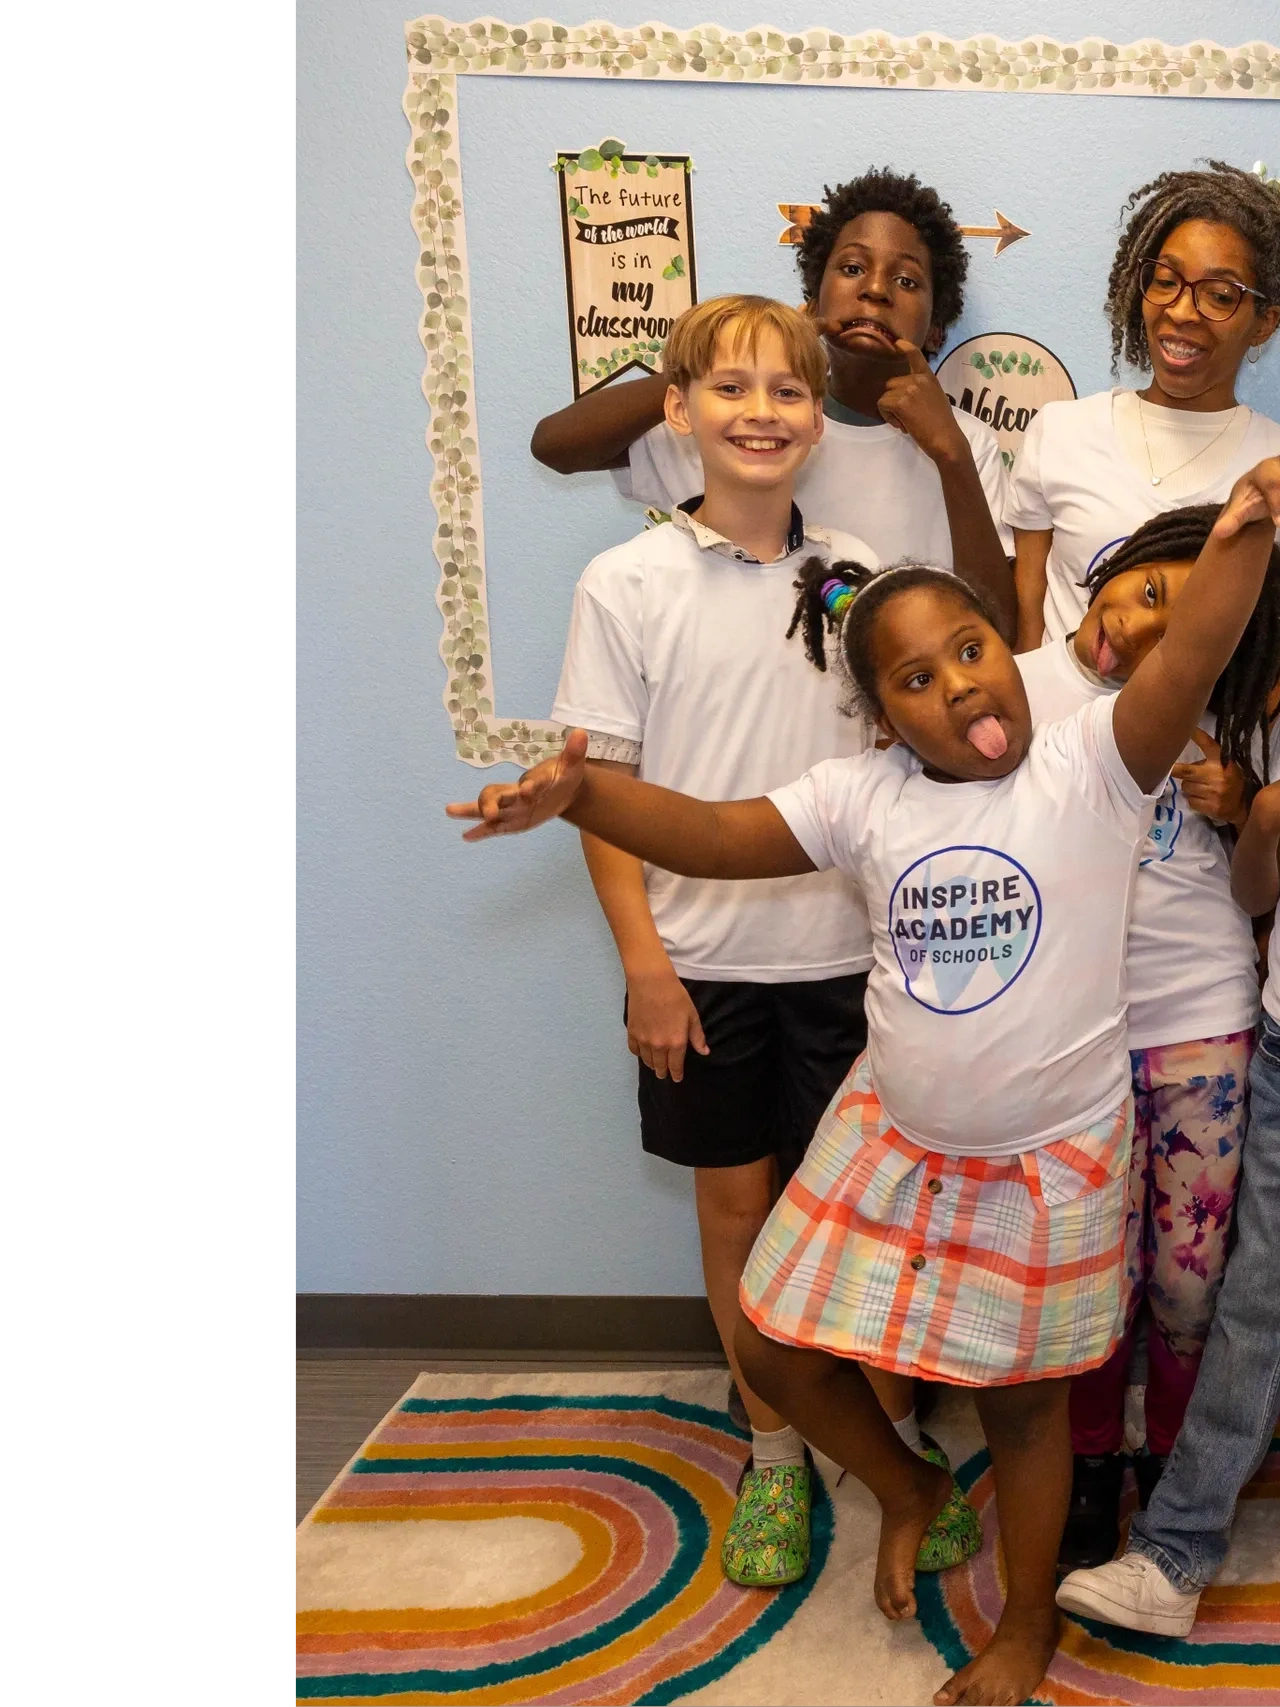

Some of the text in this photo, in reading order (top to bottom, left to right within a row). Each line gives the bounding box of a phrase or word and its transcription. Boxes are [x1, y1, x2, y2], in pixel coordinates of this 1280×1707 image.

[575, 186, 682, 208] The future
[584, 217, 670, 243] of the world
[611, 252, 651, 269] is in
[612, 281, 654, 312] my
[945, 387, 1038, 432] Welco
[902, 875, 1021, 909] INSP!RE
[895, 905, 1034, 940] ACADEMY
[910, 944, 1013, 964] OF SCHOOLS
